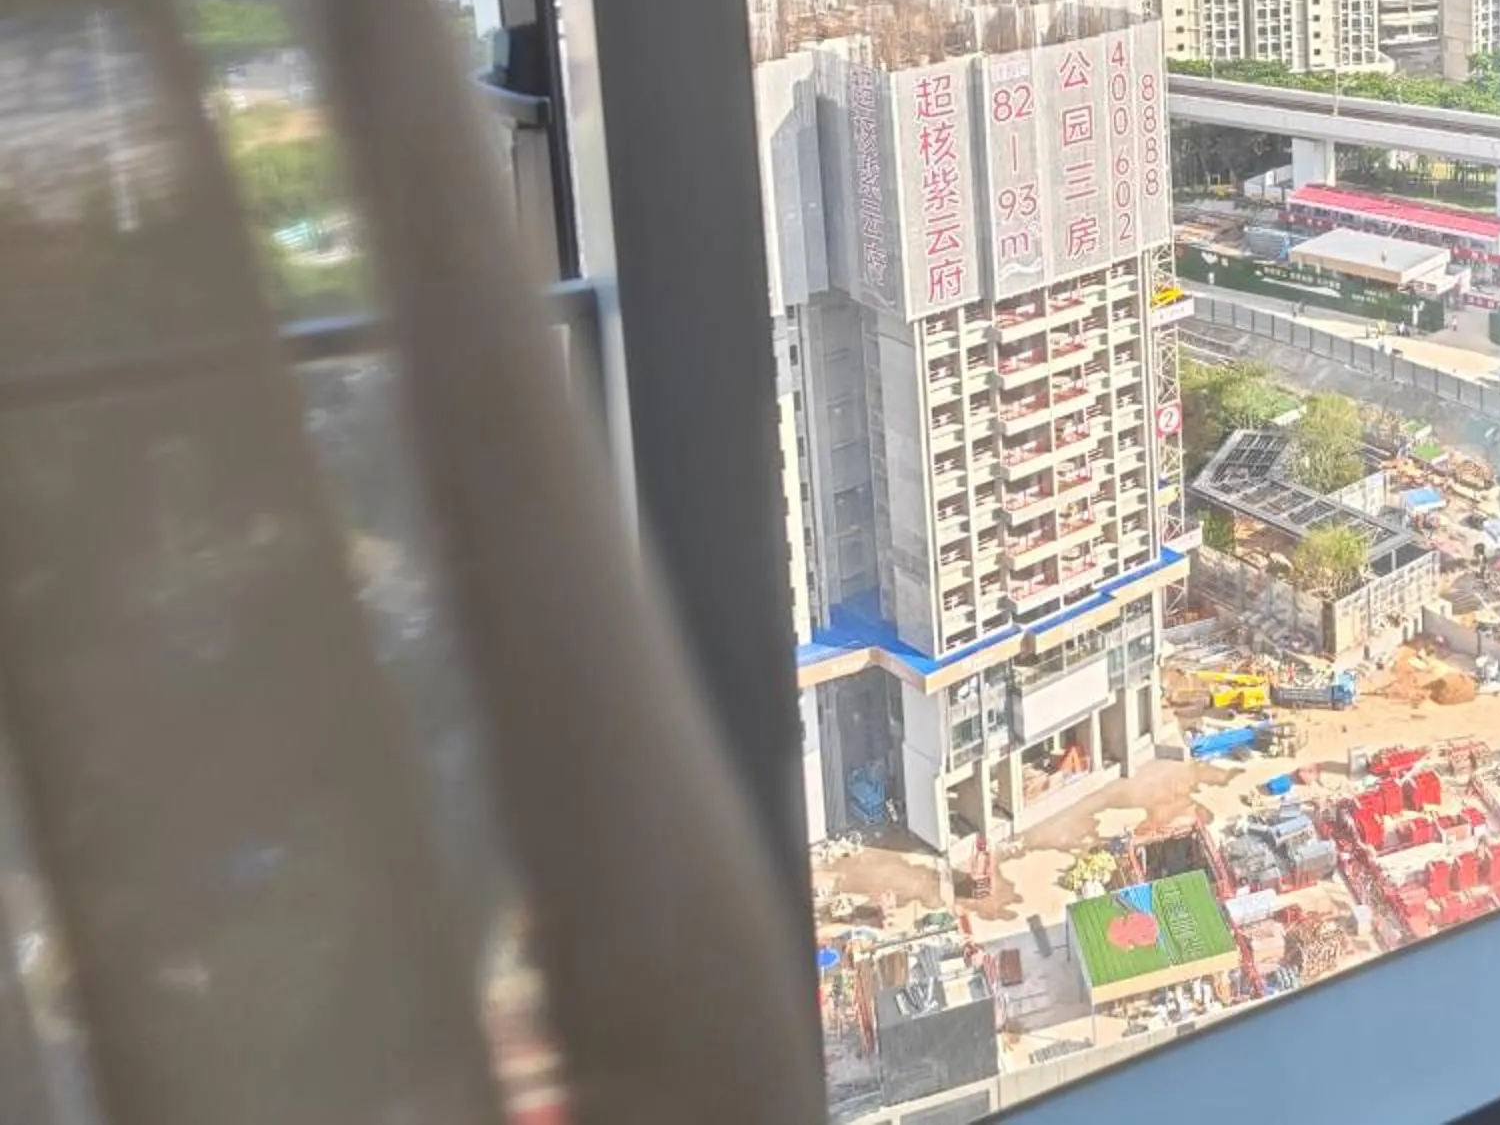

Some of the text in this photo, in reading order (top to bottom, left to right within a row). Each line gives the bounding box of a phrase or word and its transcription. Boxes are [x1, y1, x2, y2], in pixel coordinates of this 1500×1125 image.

[916, 74, 964, 304] 超核紫云府
[1059, 50, 1097, 259] 公园三房
[1141, 74, 1160, 196] 8888
